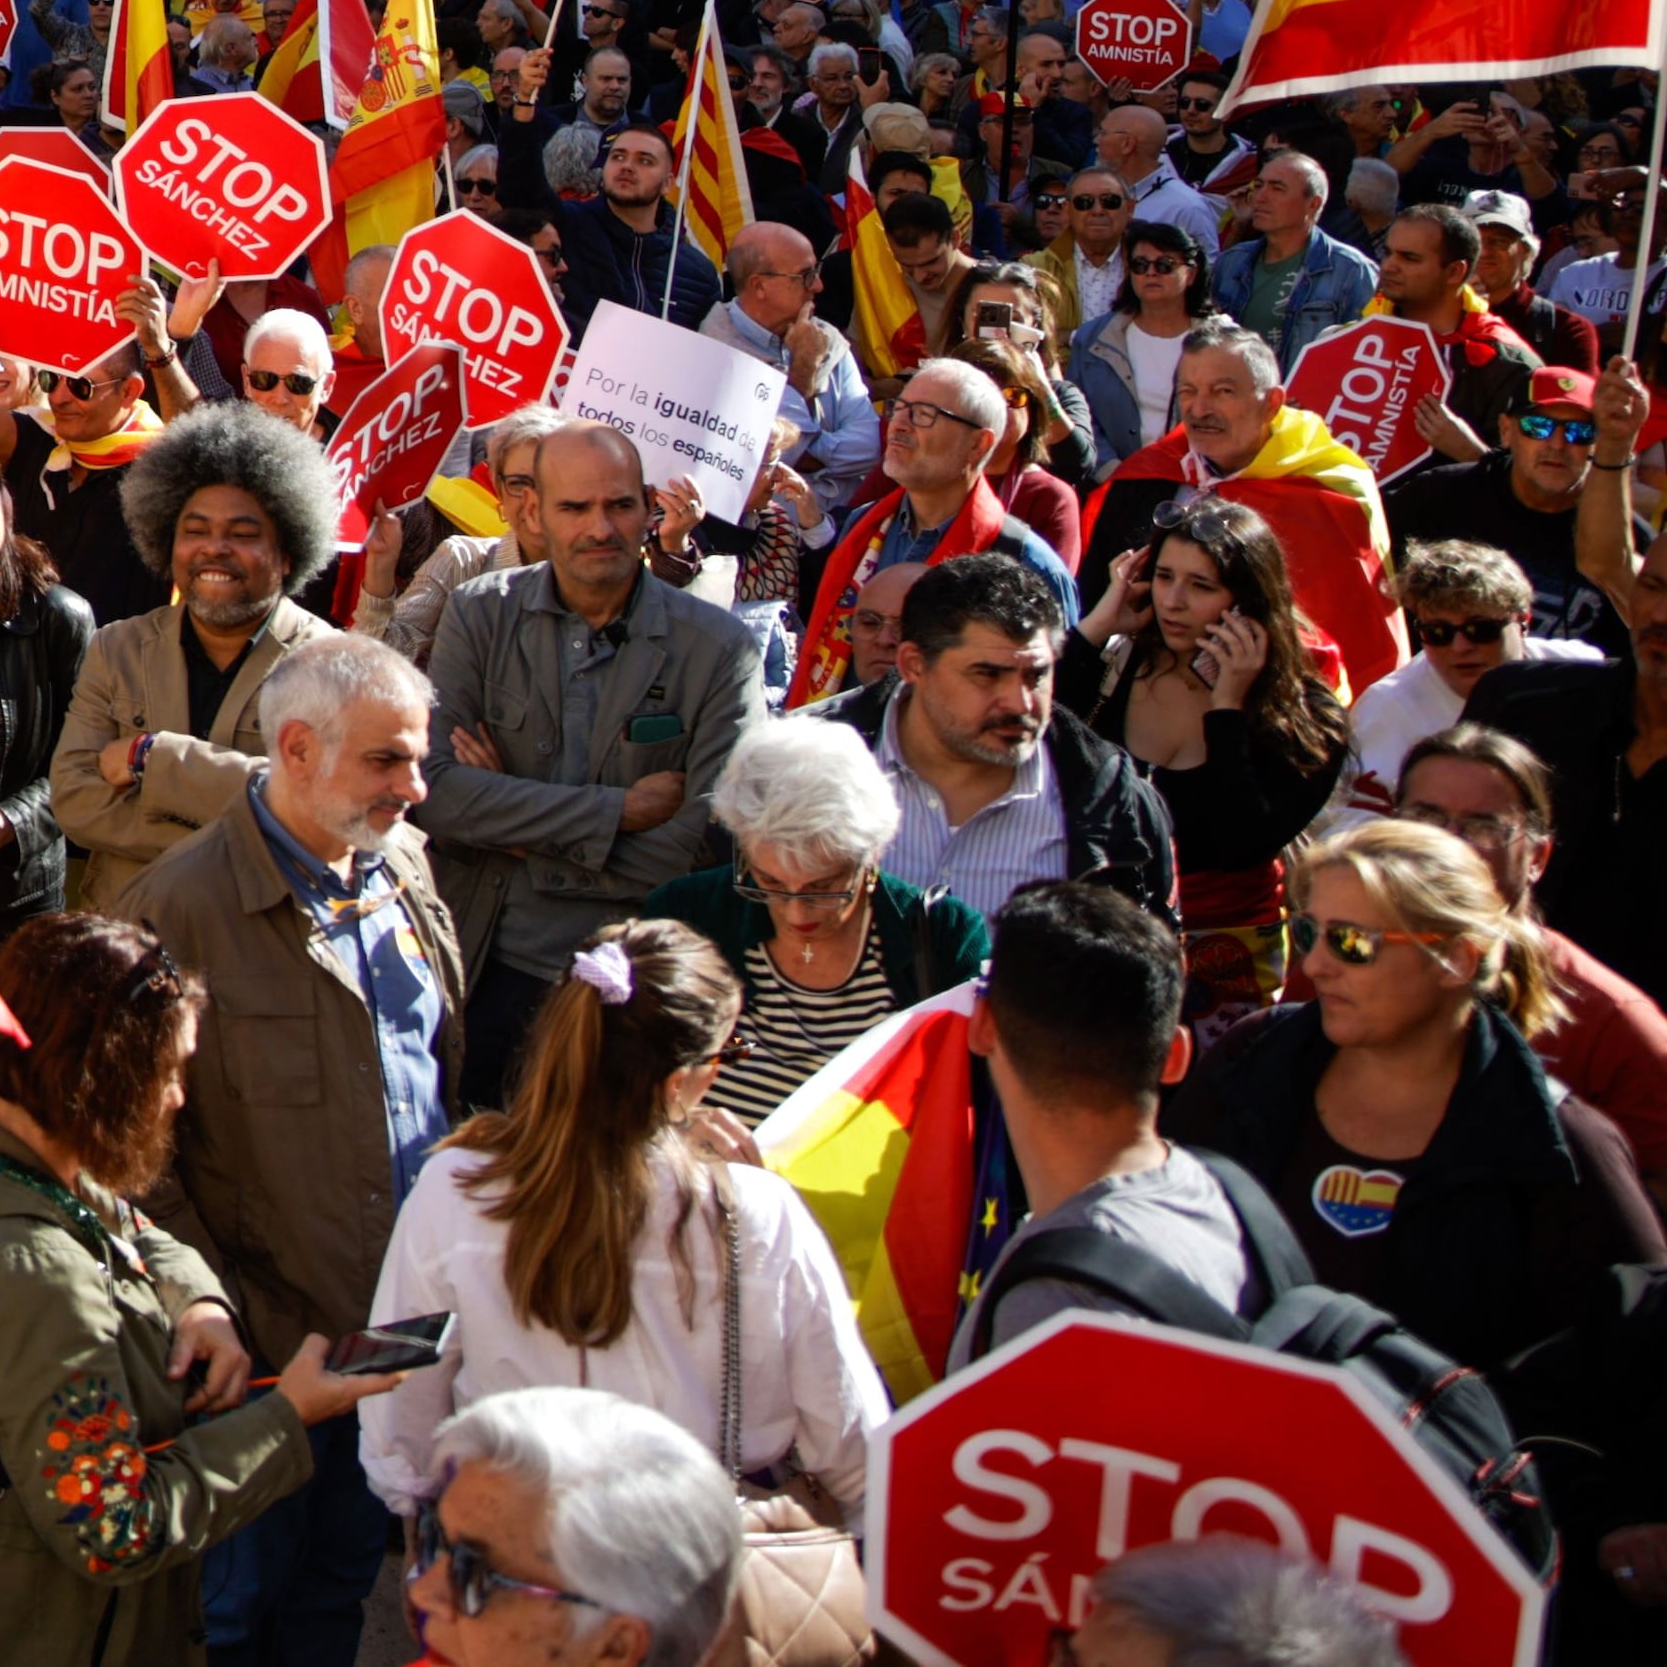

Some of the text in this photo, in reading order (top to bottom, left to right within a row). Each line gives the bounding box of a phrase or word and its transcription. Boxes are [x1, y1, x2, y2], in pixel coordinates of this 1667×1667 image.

[1087, 43, 1174, 66] AMNISTÍA
[1088, 11, 1177, 46] STOP
[135, 157, 272, 263] SÁNCHEZ
[160, 117, 309, 226] STOP
[389, 302, 525, 400] SÁNHEZ
[401, 247, 545, 359] STOP
[332, 364, 444, 486] STOP
[578, 400, 745, 482] todos los españoles
[585, 368, 625, 396] Por
[629, 383, 649, 406] la
[653, 391, 738, 442] igualdad
[738, 428, 756, 452] de
[1367, 344, 1422, 474] AMNISTÍA
[342, 411, 443, 512] ÁNCHEZ
